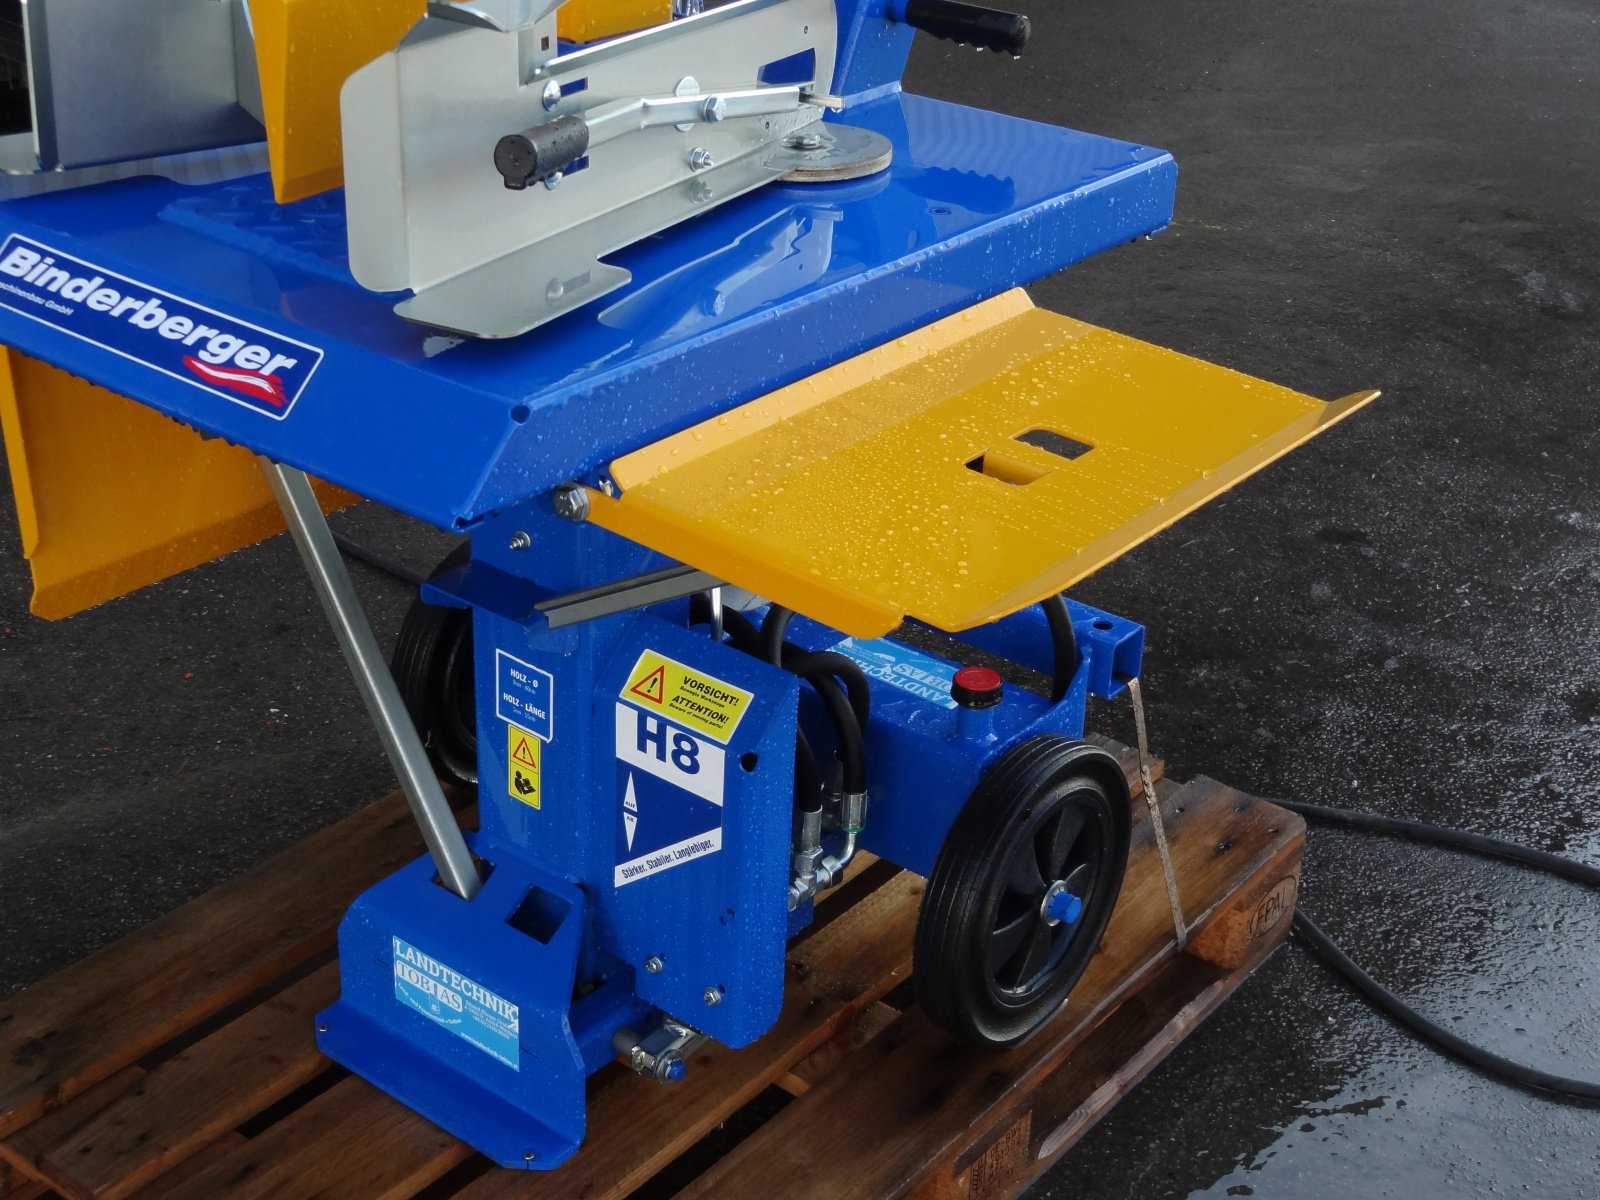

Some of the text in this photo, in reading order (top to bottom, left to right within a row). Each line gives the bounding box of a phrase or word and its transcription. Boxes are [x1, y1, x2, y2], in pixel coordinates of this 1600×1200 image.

[0, 246, 298, 376] Binderberger
[510, 668, 527, 683] HOLZ
[682, 676, 740, 706] VORSICHT!
[503, 692, 520, 708] HOLZ
[525, 702, 546, 720] LÄNGE
[669, 702, 687, 714] Beware
[672, 695, 730, 724] ATTENTION!
[636, 711, 701, 775] H8
[622, 838, 715, 879] Stärker. Stabiler. Langlebiger.
[395, 939, 517, 1022] LANDTECHNIK
[397, 962, 461, 1010] TOBIAS
